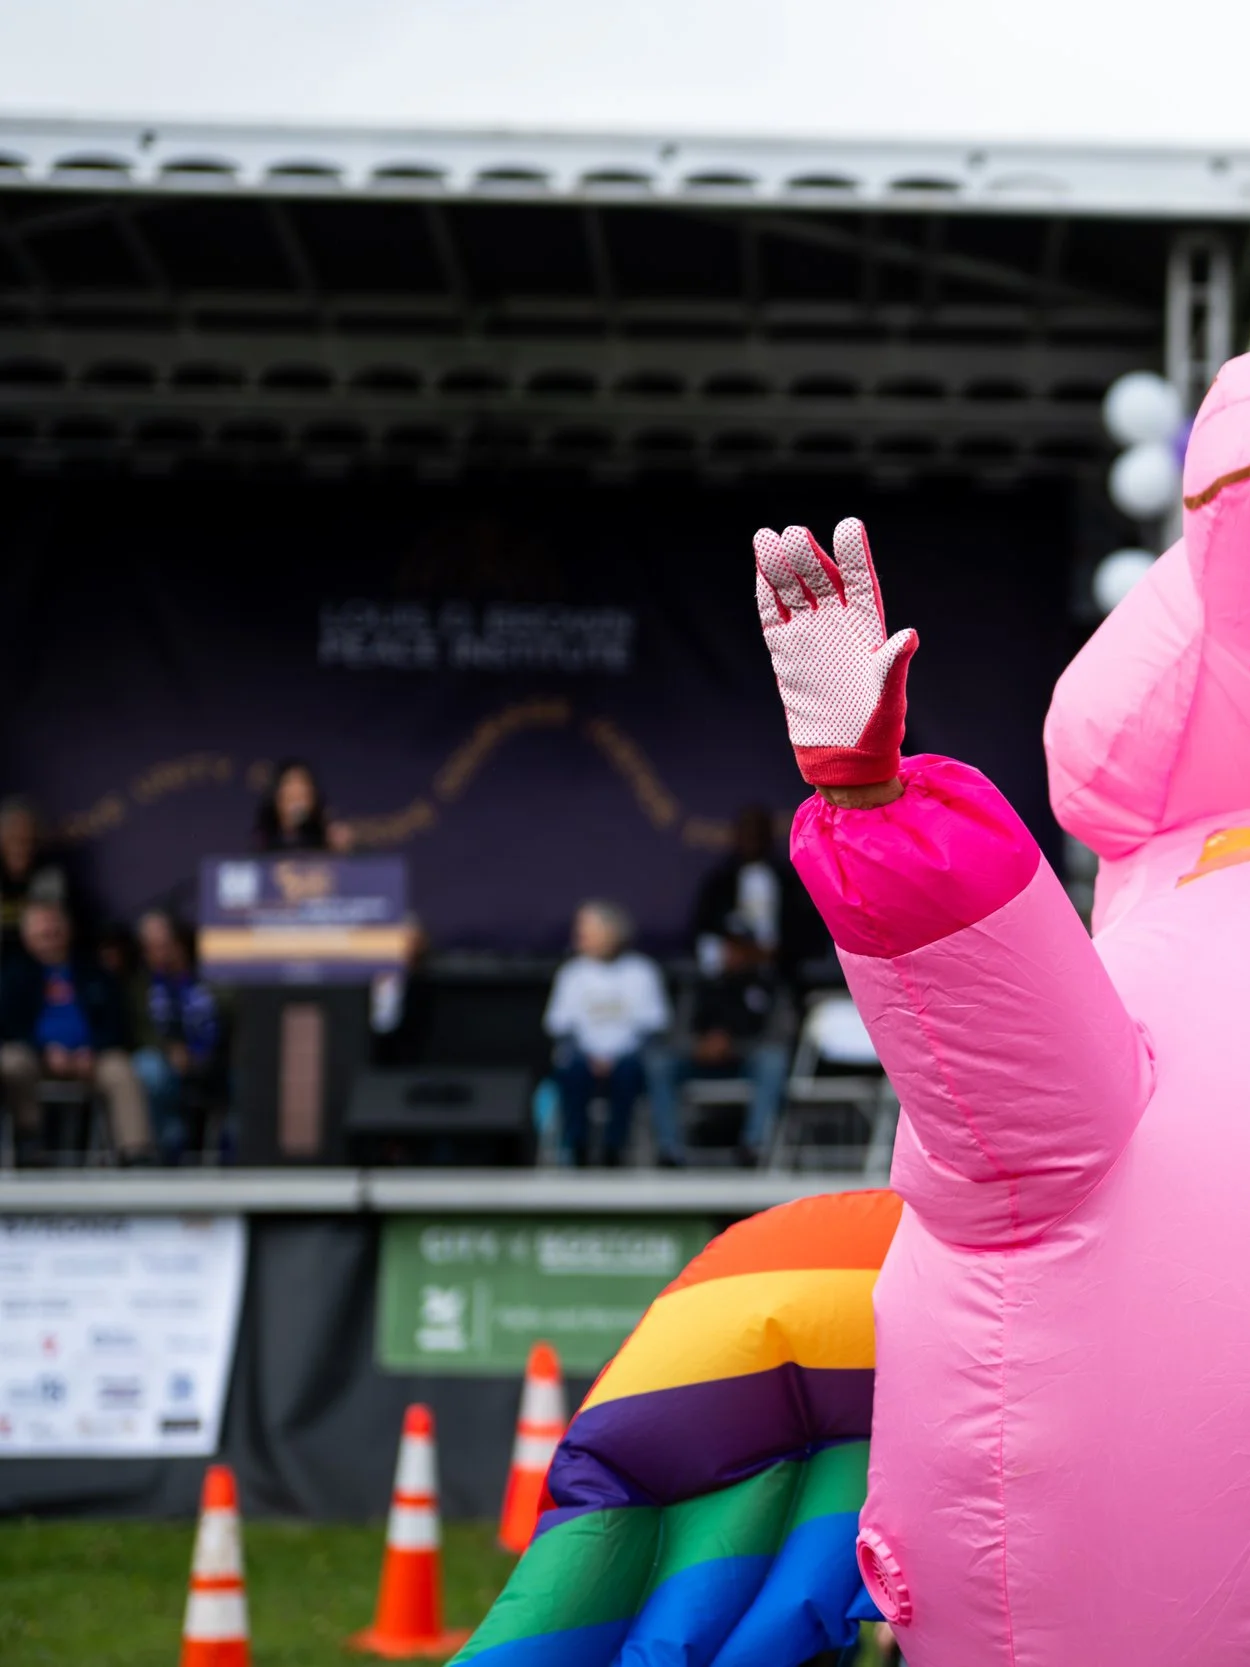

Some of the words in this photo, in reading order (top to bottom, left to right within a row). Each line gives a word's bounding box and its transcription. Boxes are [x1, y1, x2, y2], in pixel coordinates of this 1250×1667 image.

[318, 632, 436, 668] PEACE
[453, 635, 630, 672] INSTITUTE
[422, 1227, 498, 1264] CITY
